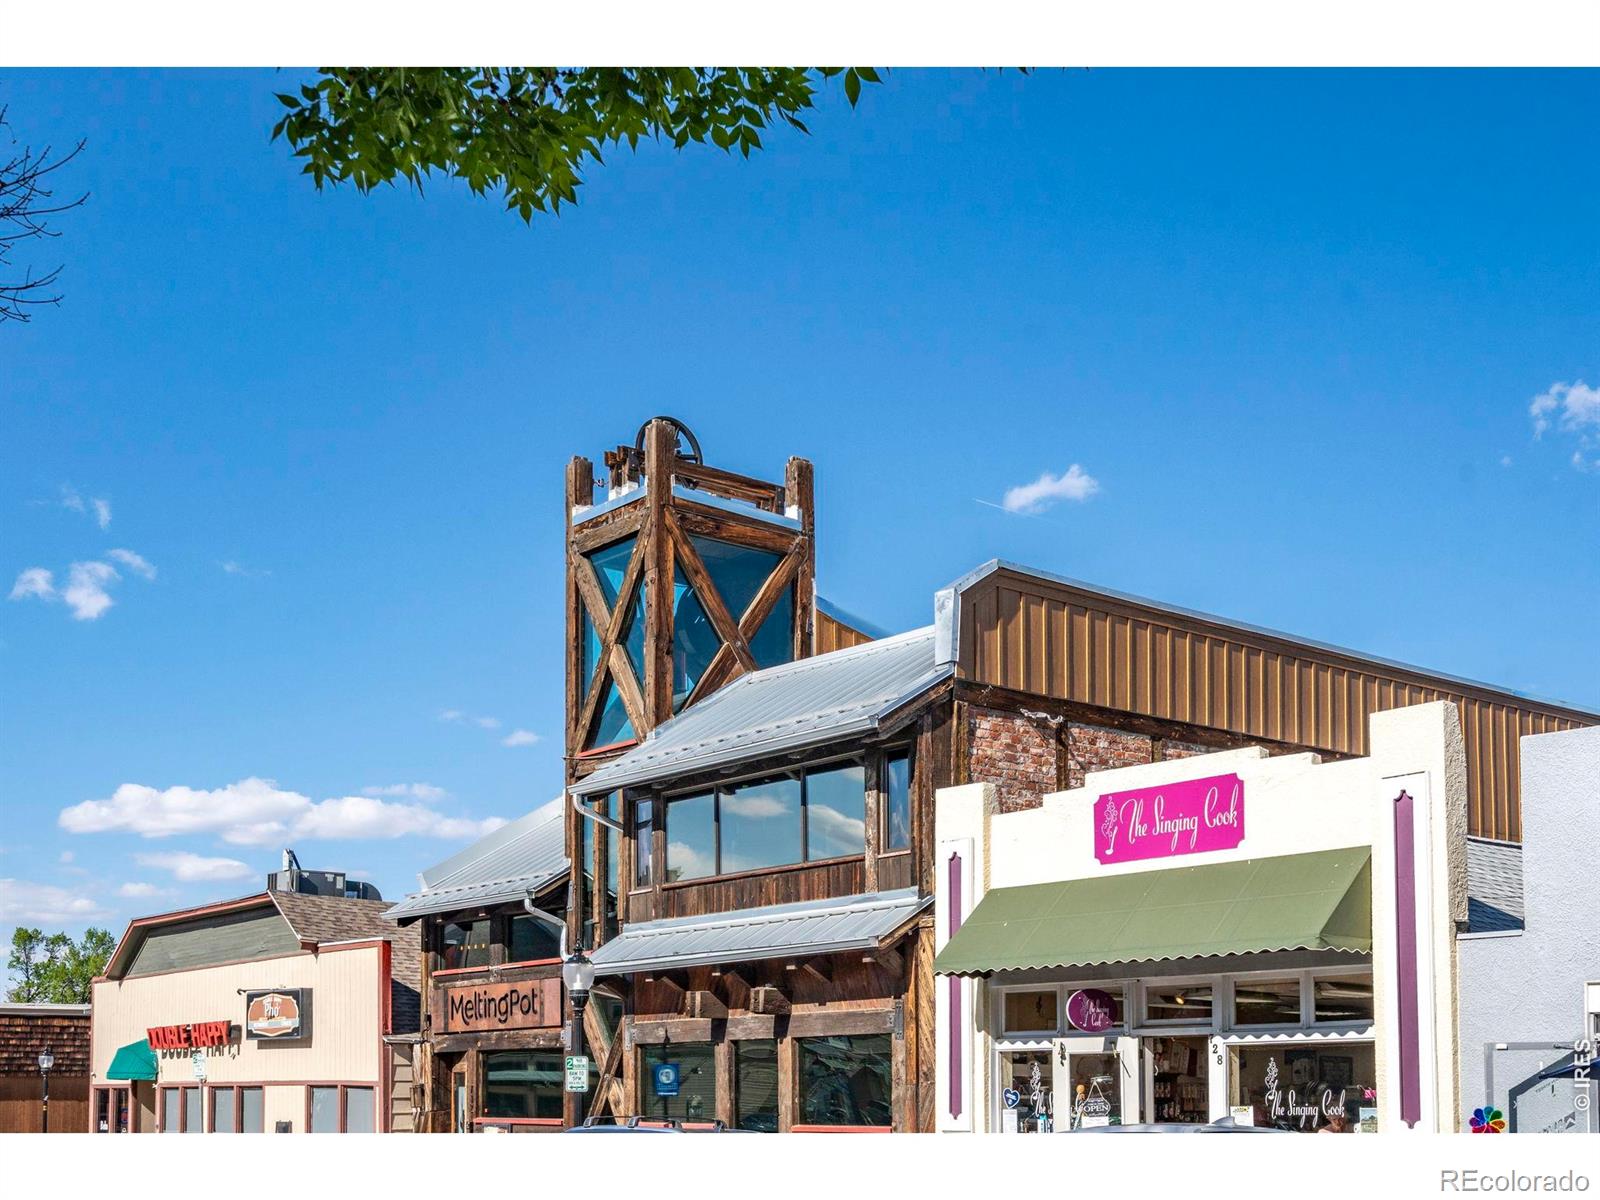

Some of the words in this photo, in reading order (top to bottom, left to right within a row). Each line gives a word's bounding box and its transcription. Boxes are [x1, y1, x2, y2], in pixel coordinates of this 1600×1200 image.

[1120, 798, 1147, 844] The
[1152, 794, 1198, 851] Singing
[1204, 784, 1240, 828] Cook
[147, 1025, 189, 1050] DOUBLE
[191, 1020, 230, 1047] HAPPY
[567, 1058, 573, 1069] 2
[1083, 1104, 1109, 1112] OPEN
[1265, 1089, 1285, 1119] The
[1287, 1089, 1319, 1128] Singing
[1322, 1089, 1346, 1118] Cook
